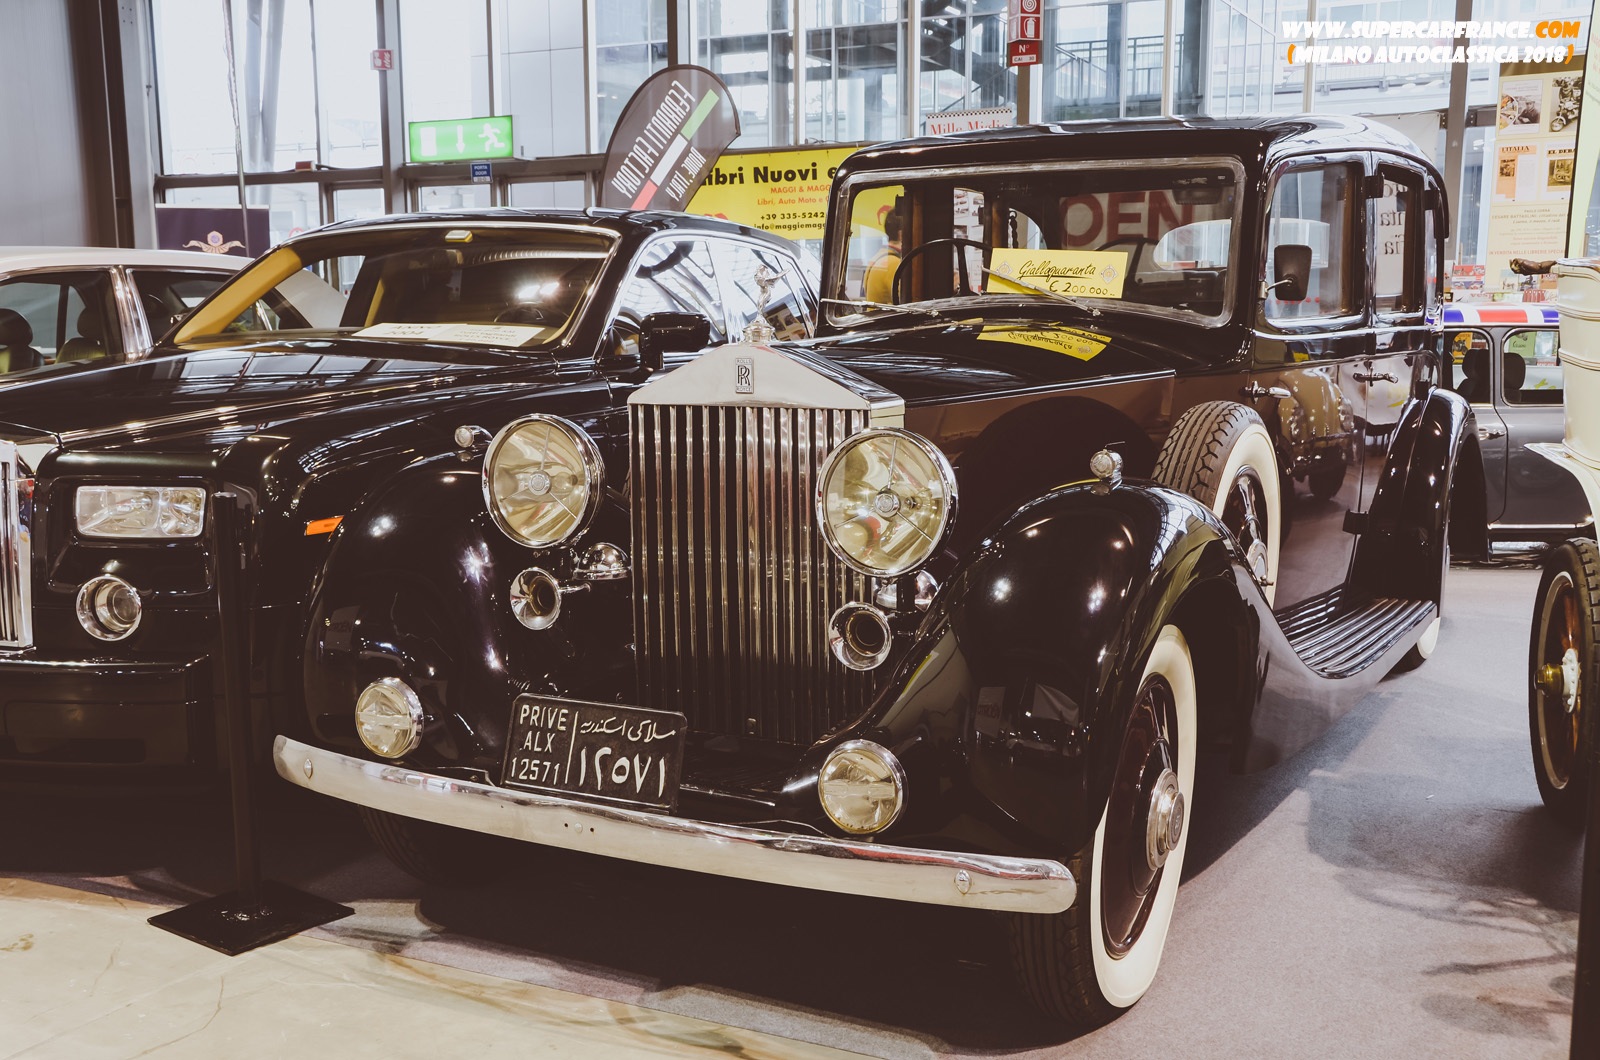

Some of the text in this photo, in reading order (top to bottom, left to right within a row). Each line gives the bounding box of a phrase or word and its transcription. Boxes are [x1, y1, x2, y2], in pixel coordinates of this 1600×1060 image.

[931, 122, 962, 135] Mille
[753, 161, 818, 184] Nuovi
[771, 186, 797, 194] MAGGI
[798, 196, 817, 204] Moto
[761, 210, 825, 221] +39 335-5242
[1061, 281, 1085, 294] 200
[519, 704, 569, 731] PRIVE
[523, 730, 556, 753] ALX
[511, 757, 561, 785] 12571
